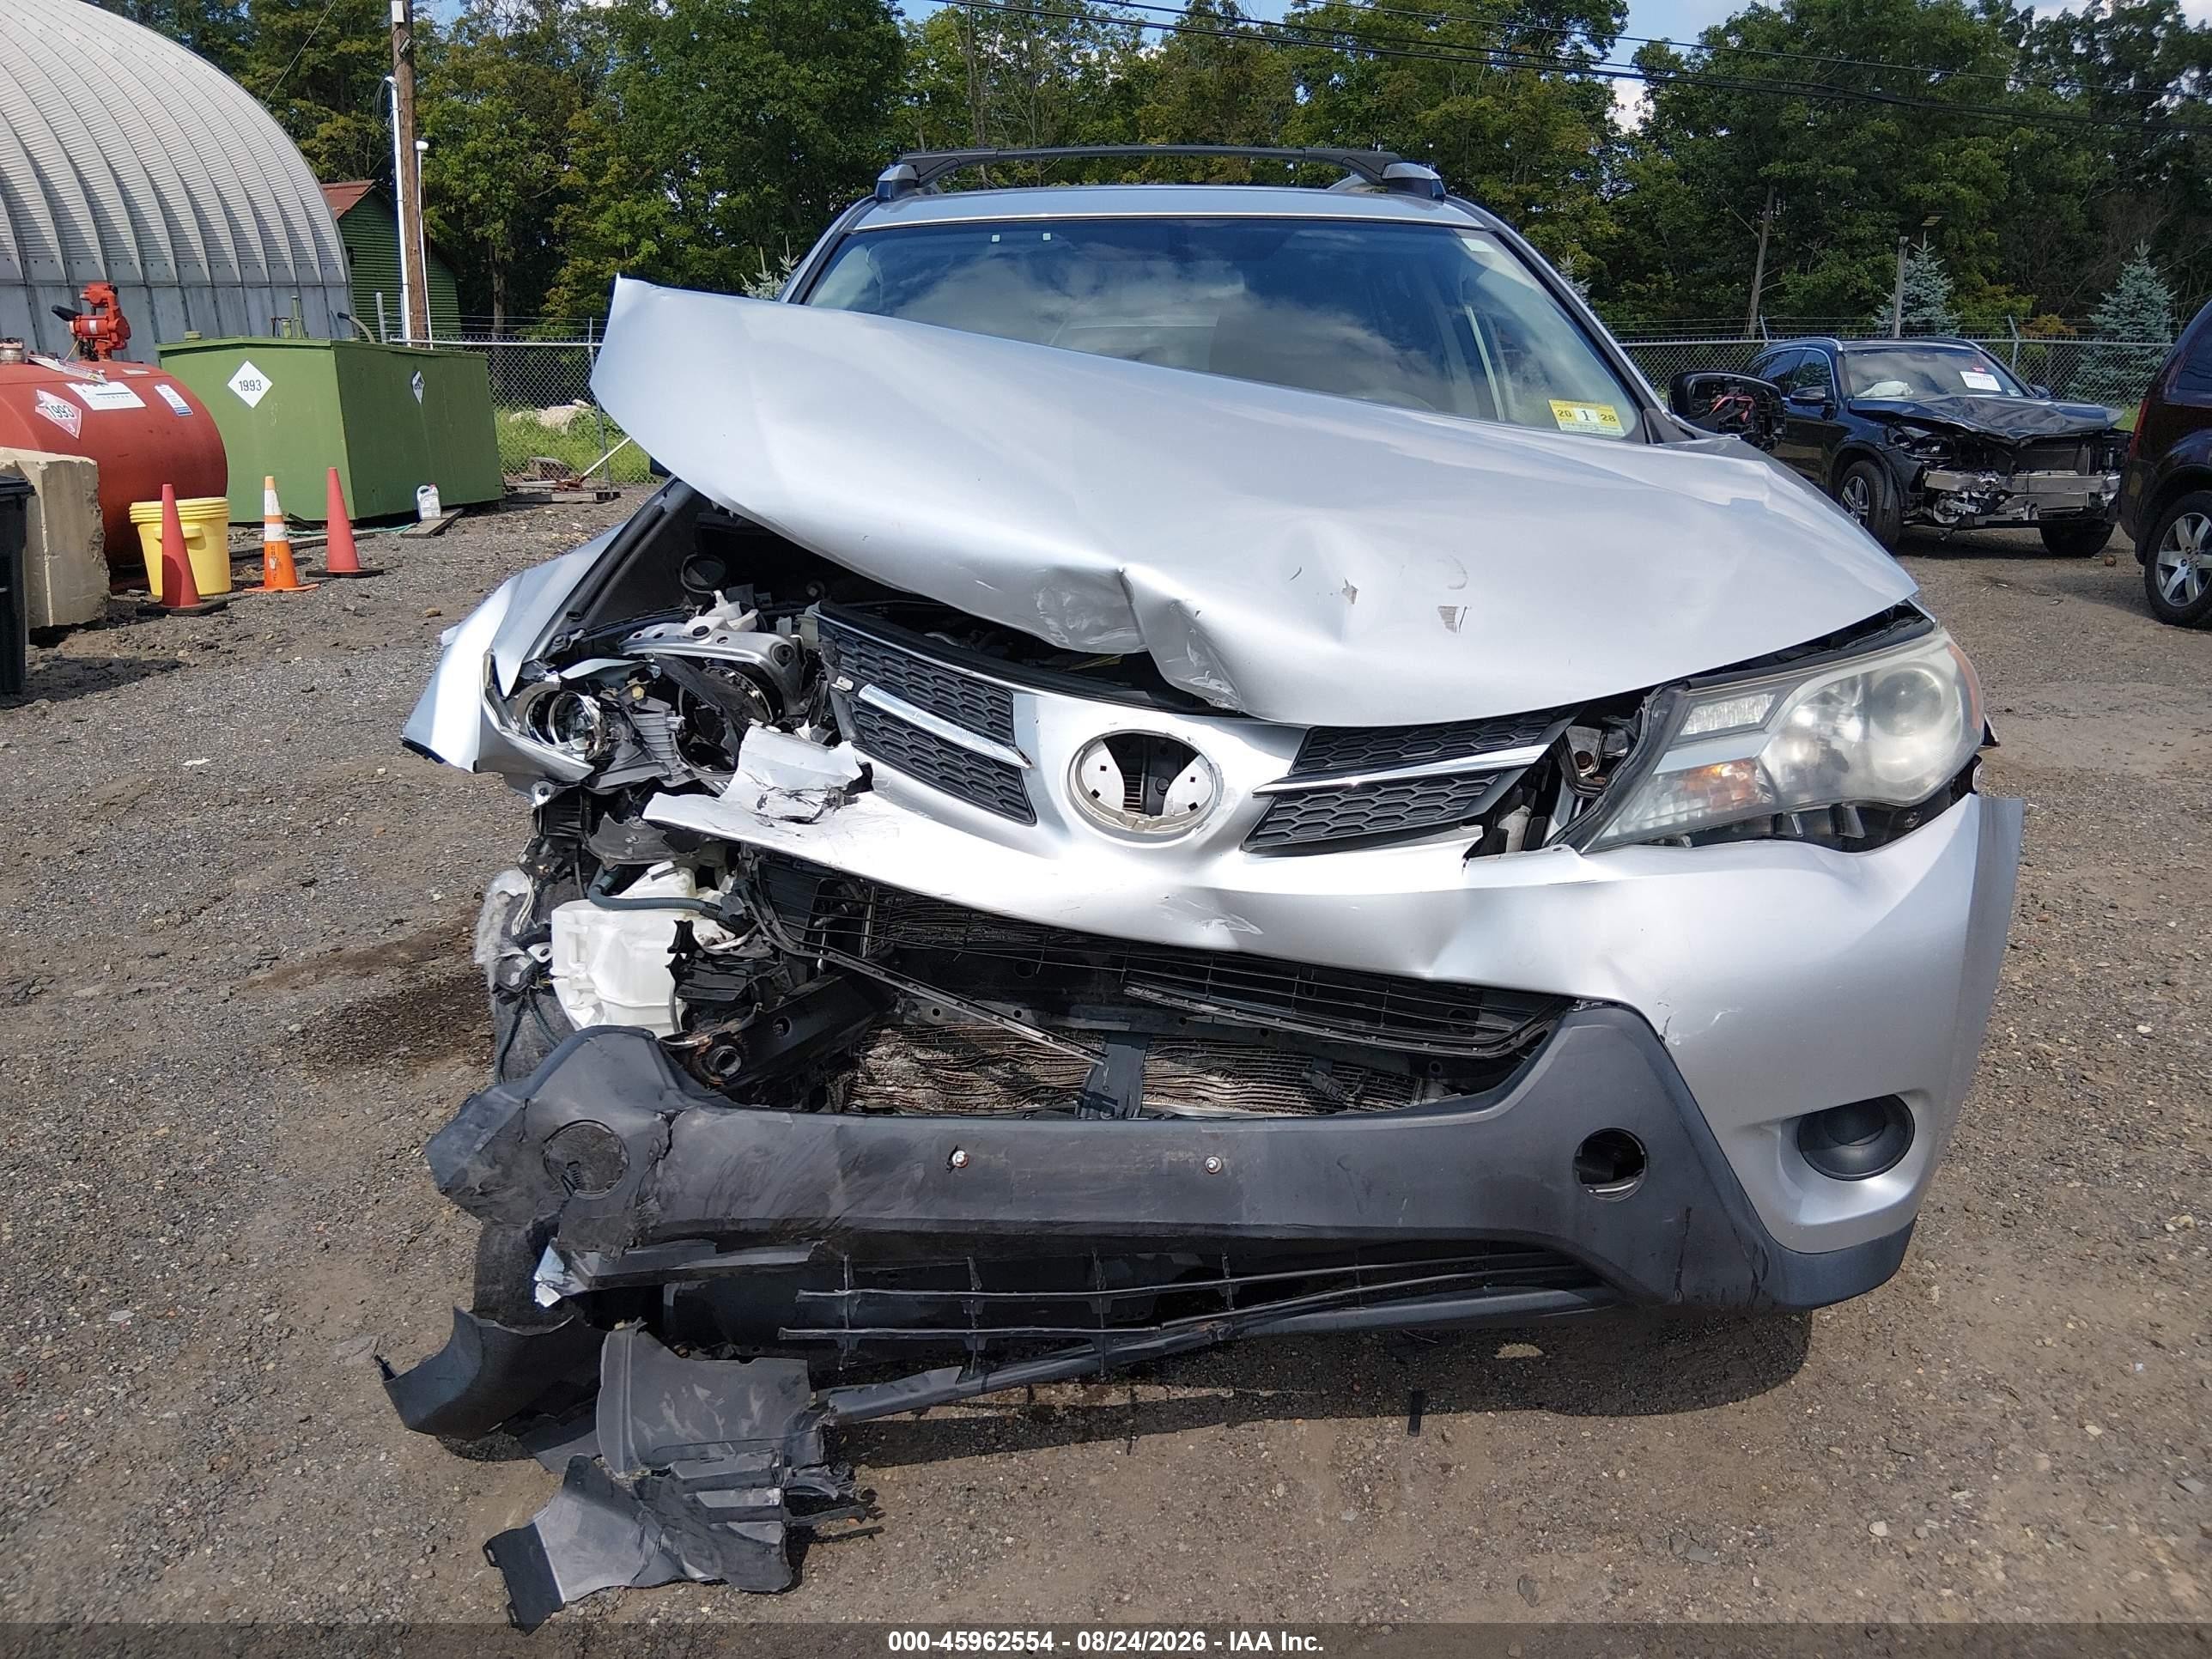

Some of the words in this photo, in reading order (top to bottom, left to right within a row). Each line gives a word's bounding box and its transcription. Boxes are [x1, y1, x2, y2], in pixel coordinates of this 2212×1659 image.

[238, 379, 262, 392] 1993
[46, 404, 75, 419] 1993
[1557, 409, 1572, 417] 20
[1581, 410, 1591, 422] 1
[1600, 413, 1616, 422] 28
[67, 423, 76, 433] 3
